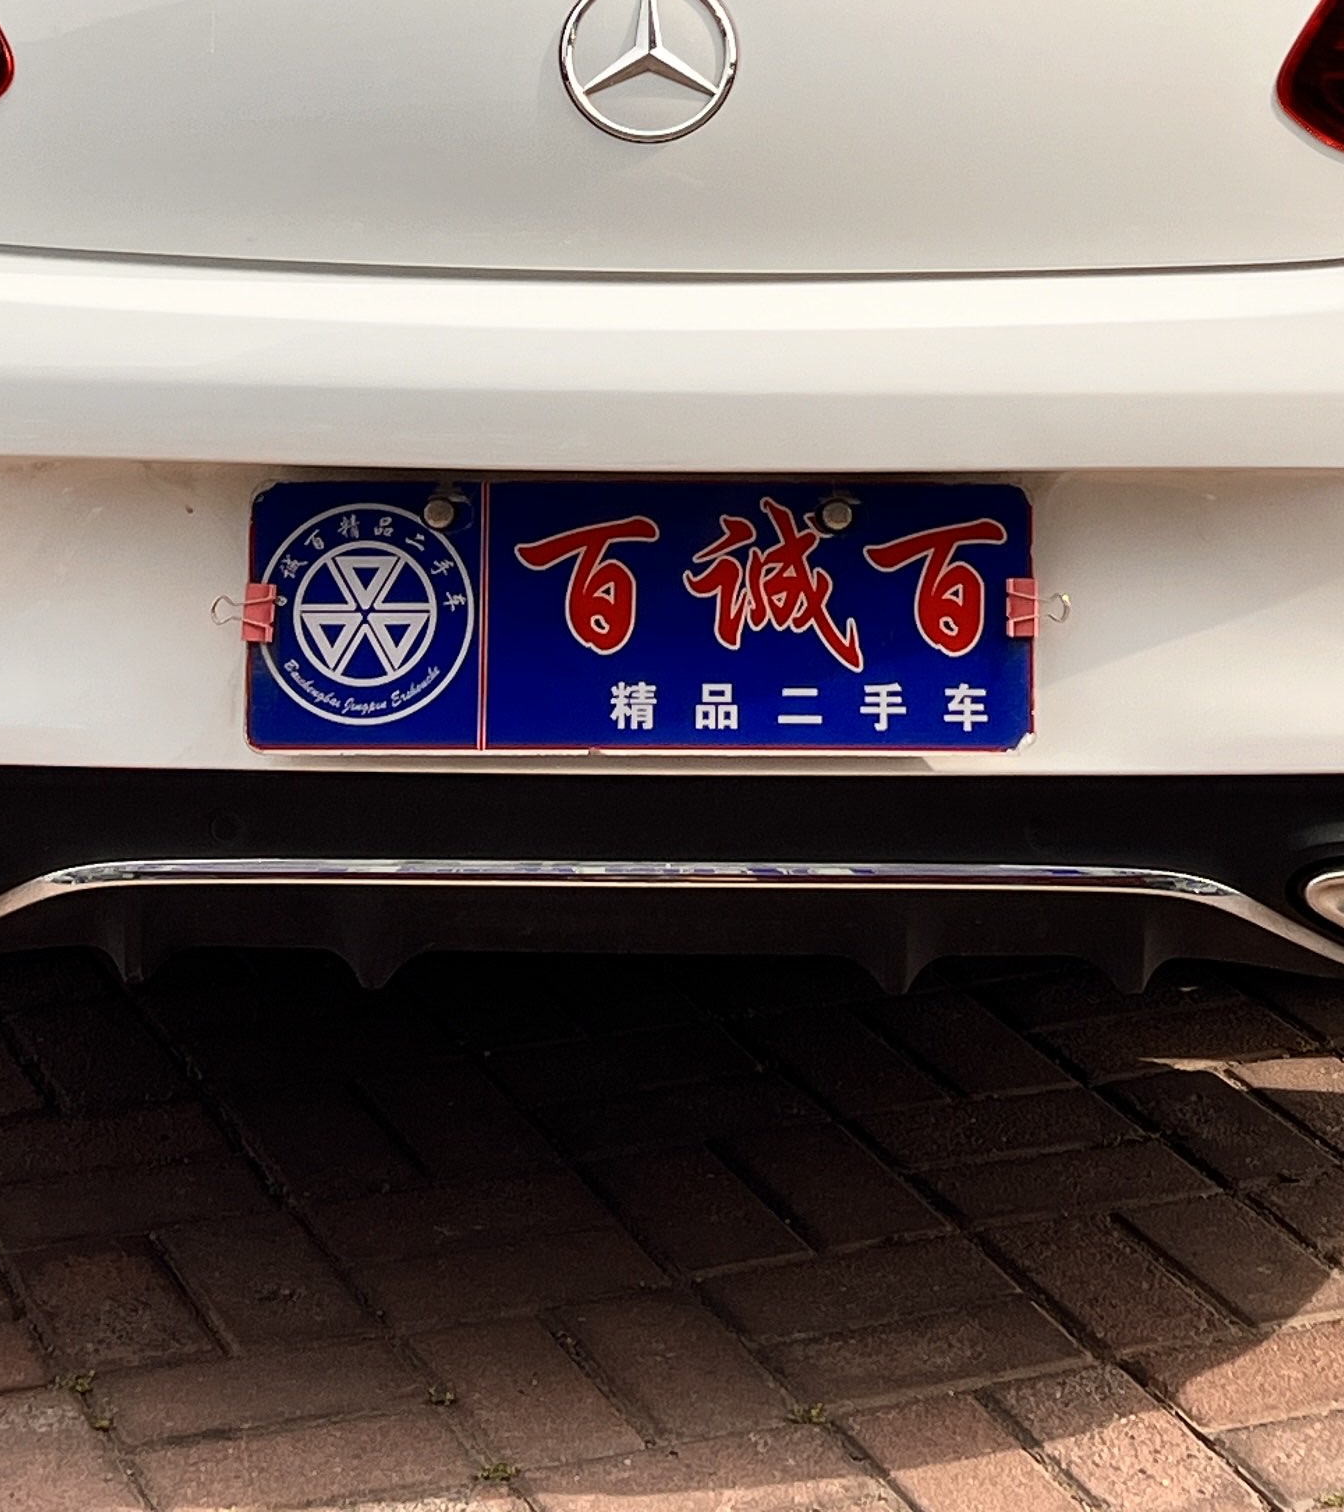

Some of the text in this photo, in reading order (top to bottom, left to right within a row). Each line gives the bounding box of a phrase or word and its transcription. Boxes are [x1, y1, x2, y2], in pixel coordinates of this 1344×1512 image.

[514, 496, 1008, 673] 百诚百
[610, 681, 989, 732] 精品二手车
